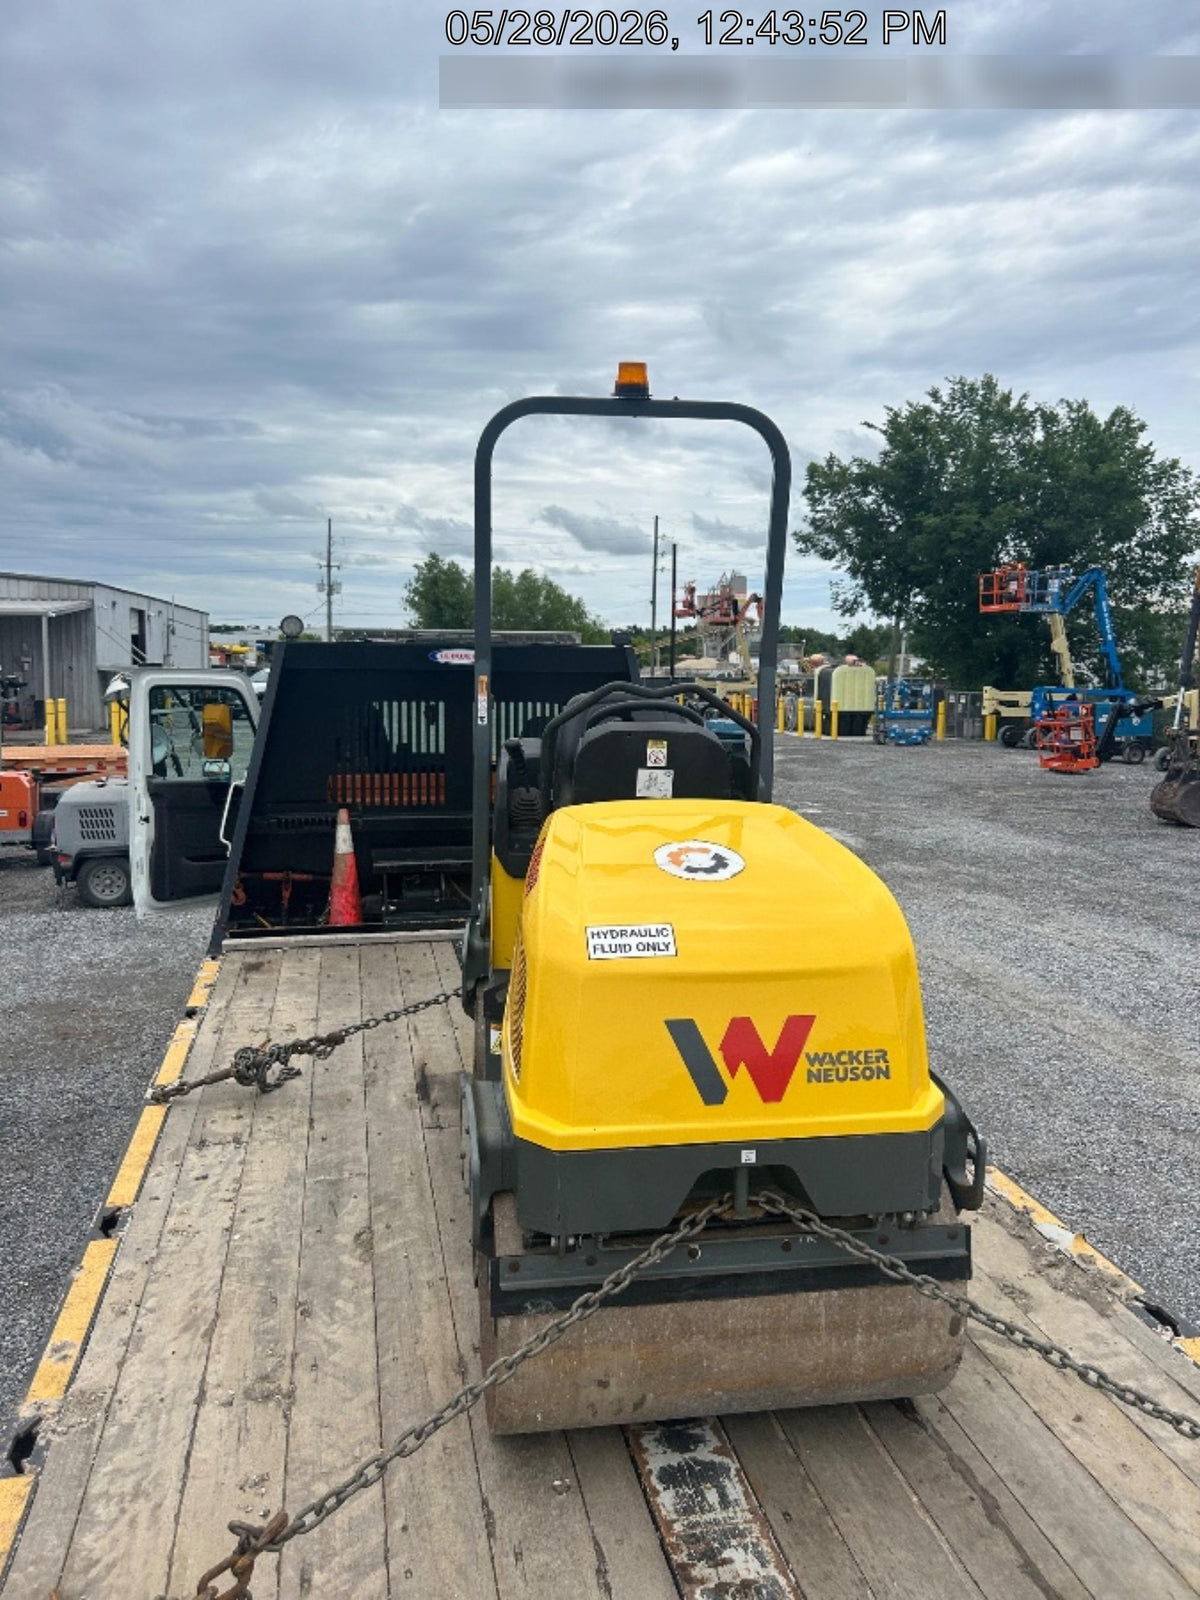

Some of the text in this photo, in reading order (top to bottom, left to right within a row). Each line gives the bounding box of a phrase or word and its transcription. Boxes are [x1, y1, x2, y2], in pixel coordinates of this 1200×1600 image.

[590, 927, 670, 940] HYDRAULIC
[593, 941, 672, 955] FLUID ONLY
[804, 1048, 890, 1067] WACKER
[806, 1065, 891, 1084] NEUSON
